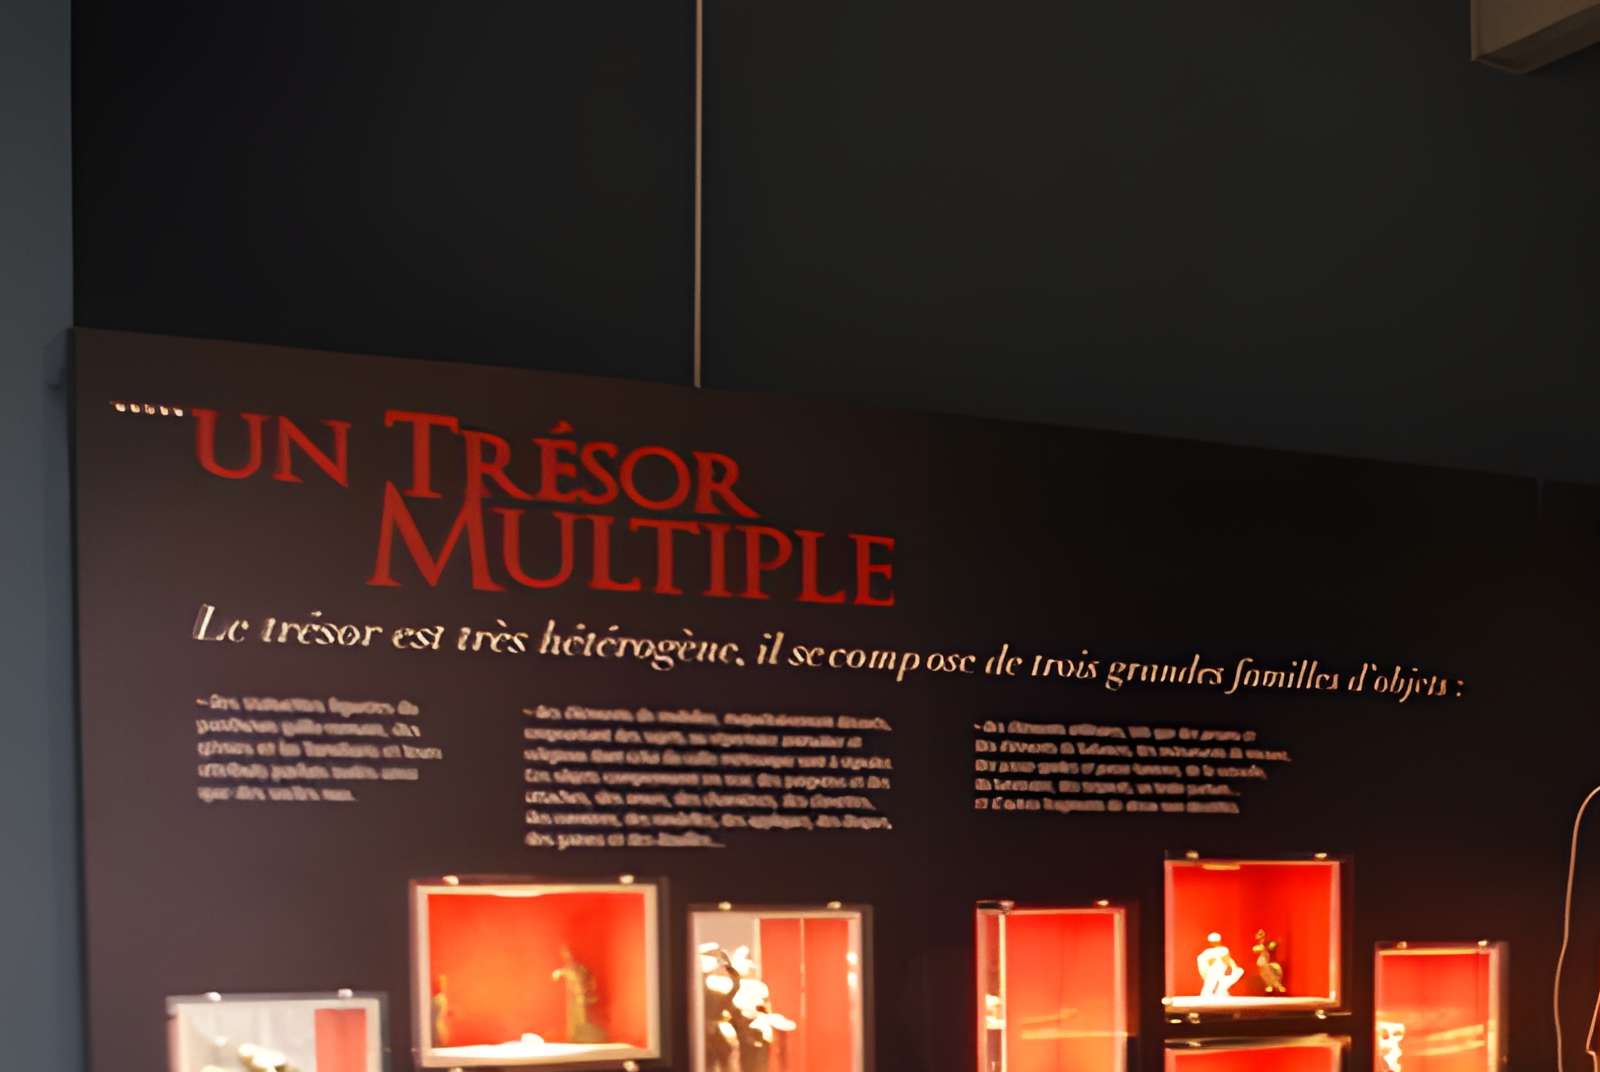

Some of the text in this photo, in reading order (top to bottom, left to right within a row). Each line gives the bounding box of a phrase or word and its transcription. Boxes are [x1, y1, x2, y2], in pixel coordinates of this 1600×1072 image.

[191, 408, 350, 487] UN
[192, 602, 250, 643] Le
[259, 609, 384, 647] trésor
[391, 624, 446, 651] est
[457, 618, 530, 654] très
[757, 630, 786, 666] il
[787, 645, 825, 667] se
[827, 648, 976, 683] compose
[984, 643, 1024, 677] de
[1031, 648, 1098, 679] trois
[1104, 652, 1226, 691] grandes
[1223, 657, 1340, 695] familles
